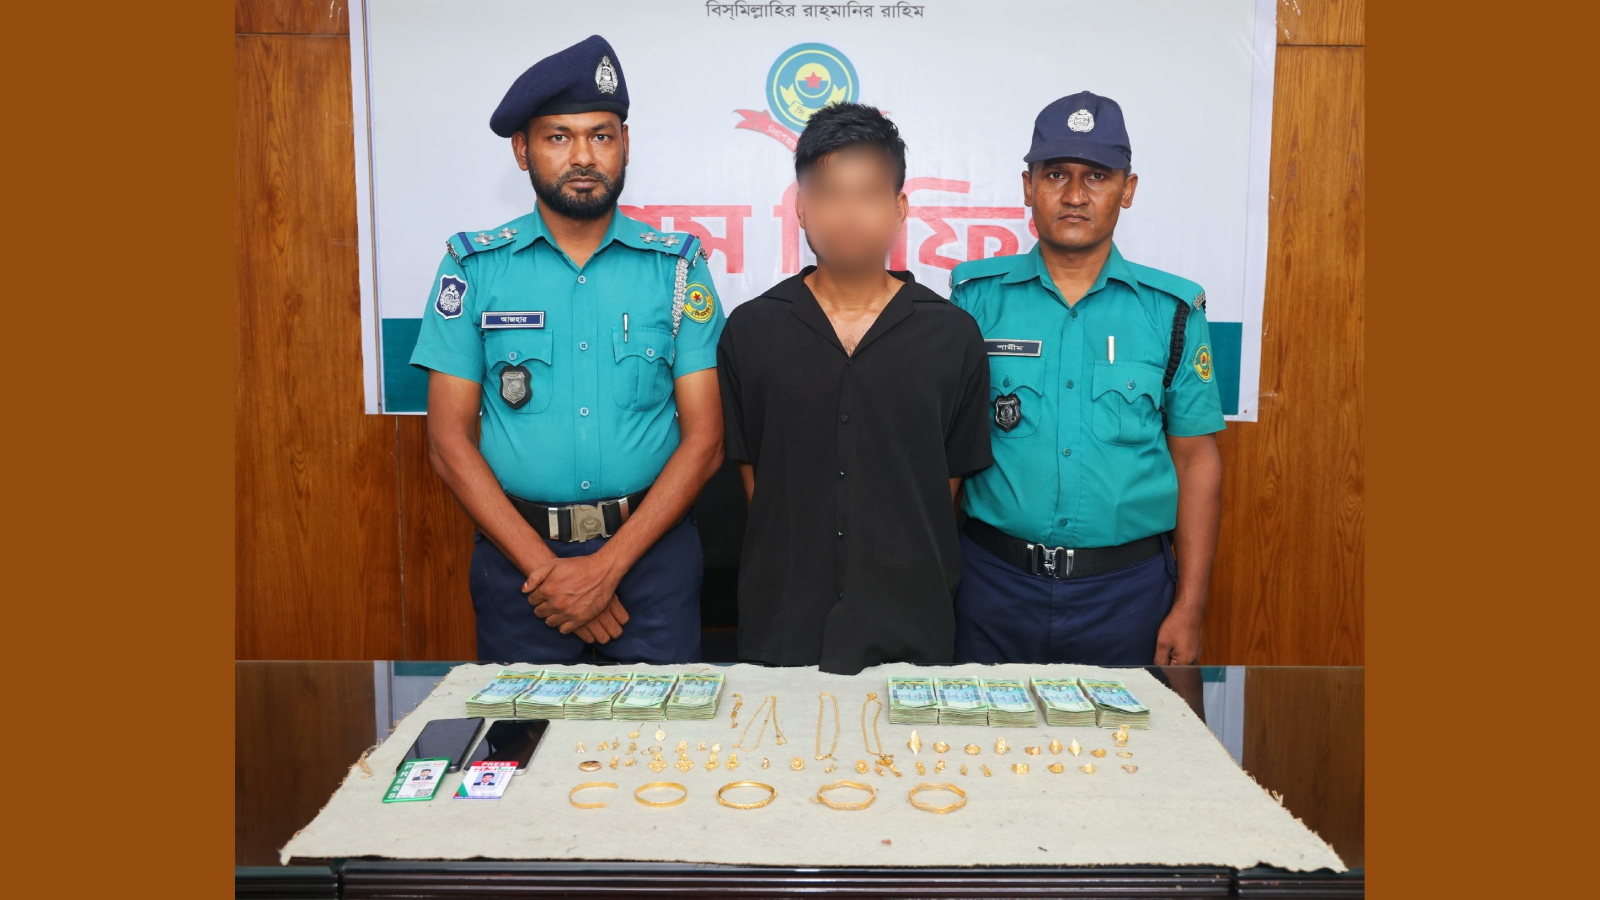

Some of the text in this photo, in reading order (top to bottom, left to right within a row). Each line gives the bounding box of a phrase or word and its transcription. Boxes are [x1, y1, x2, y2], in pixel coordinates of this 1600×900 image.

[879, 1, 925, 19] রাহিম
[996, 343, 1024, 351] শামীম
[388, 764, 413, 799] PRESS
